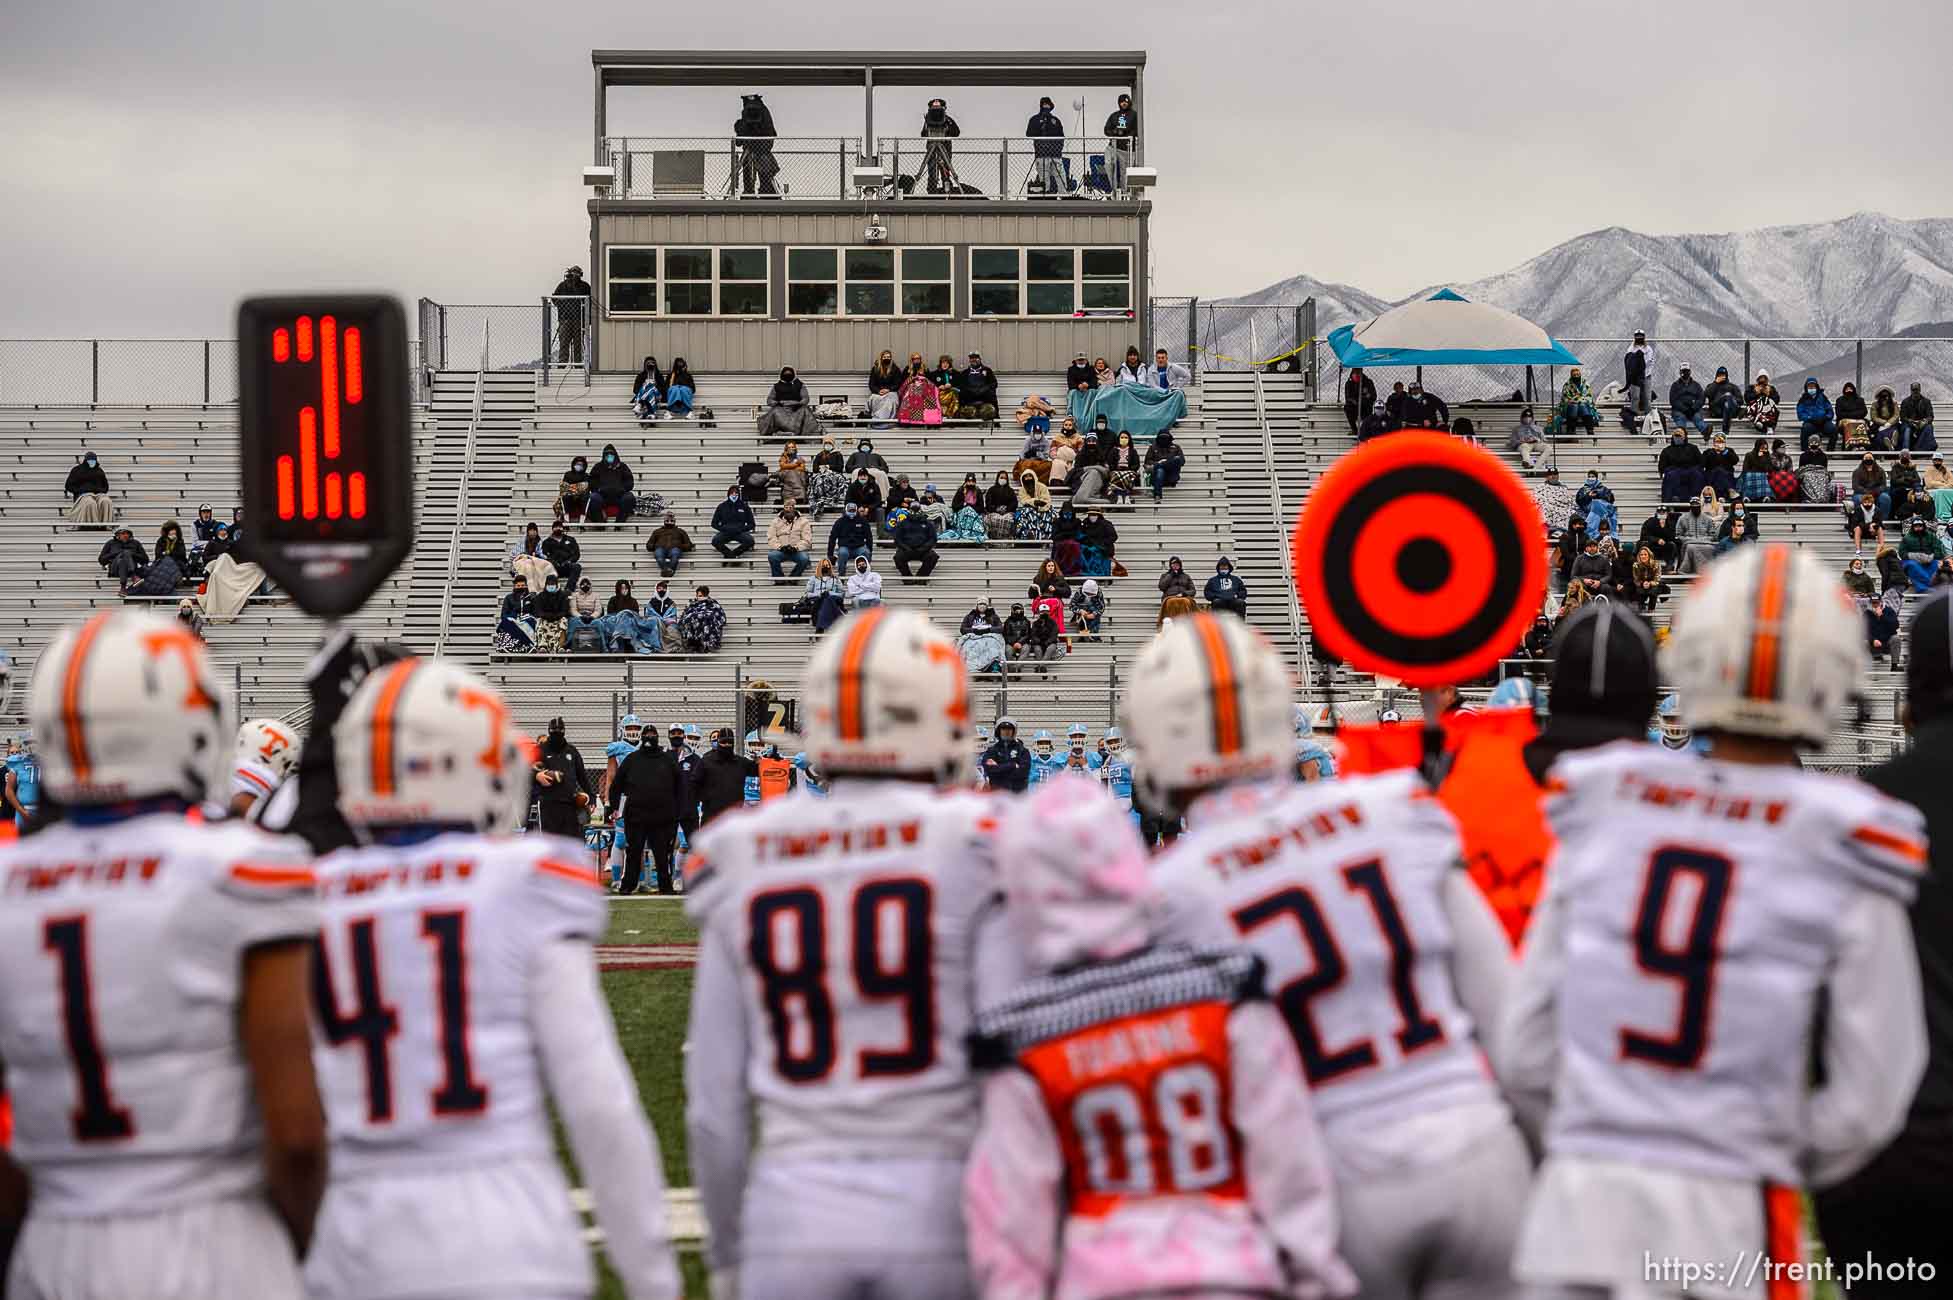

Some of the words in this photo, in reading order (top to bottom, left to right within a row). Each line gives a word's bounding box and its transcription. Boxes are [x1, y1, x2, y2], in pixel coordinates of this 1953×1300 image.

[259, 727, 289, 758] T
[41, 913, 136, 1145] 1
[310, 907, 489, 1125] 41
[747, 876, 935, 1084] 89
[1229, 850, 1446, 1092] 21
[1617, 841, 1736, 1072] 9
[1072, 1060, 1234, 1196] 08
